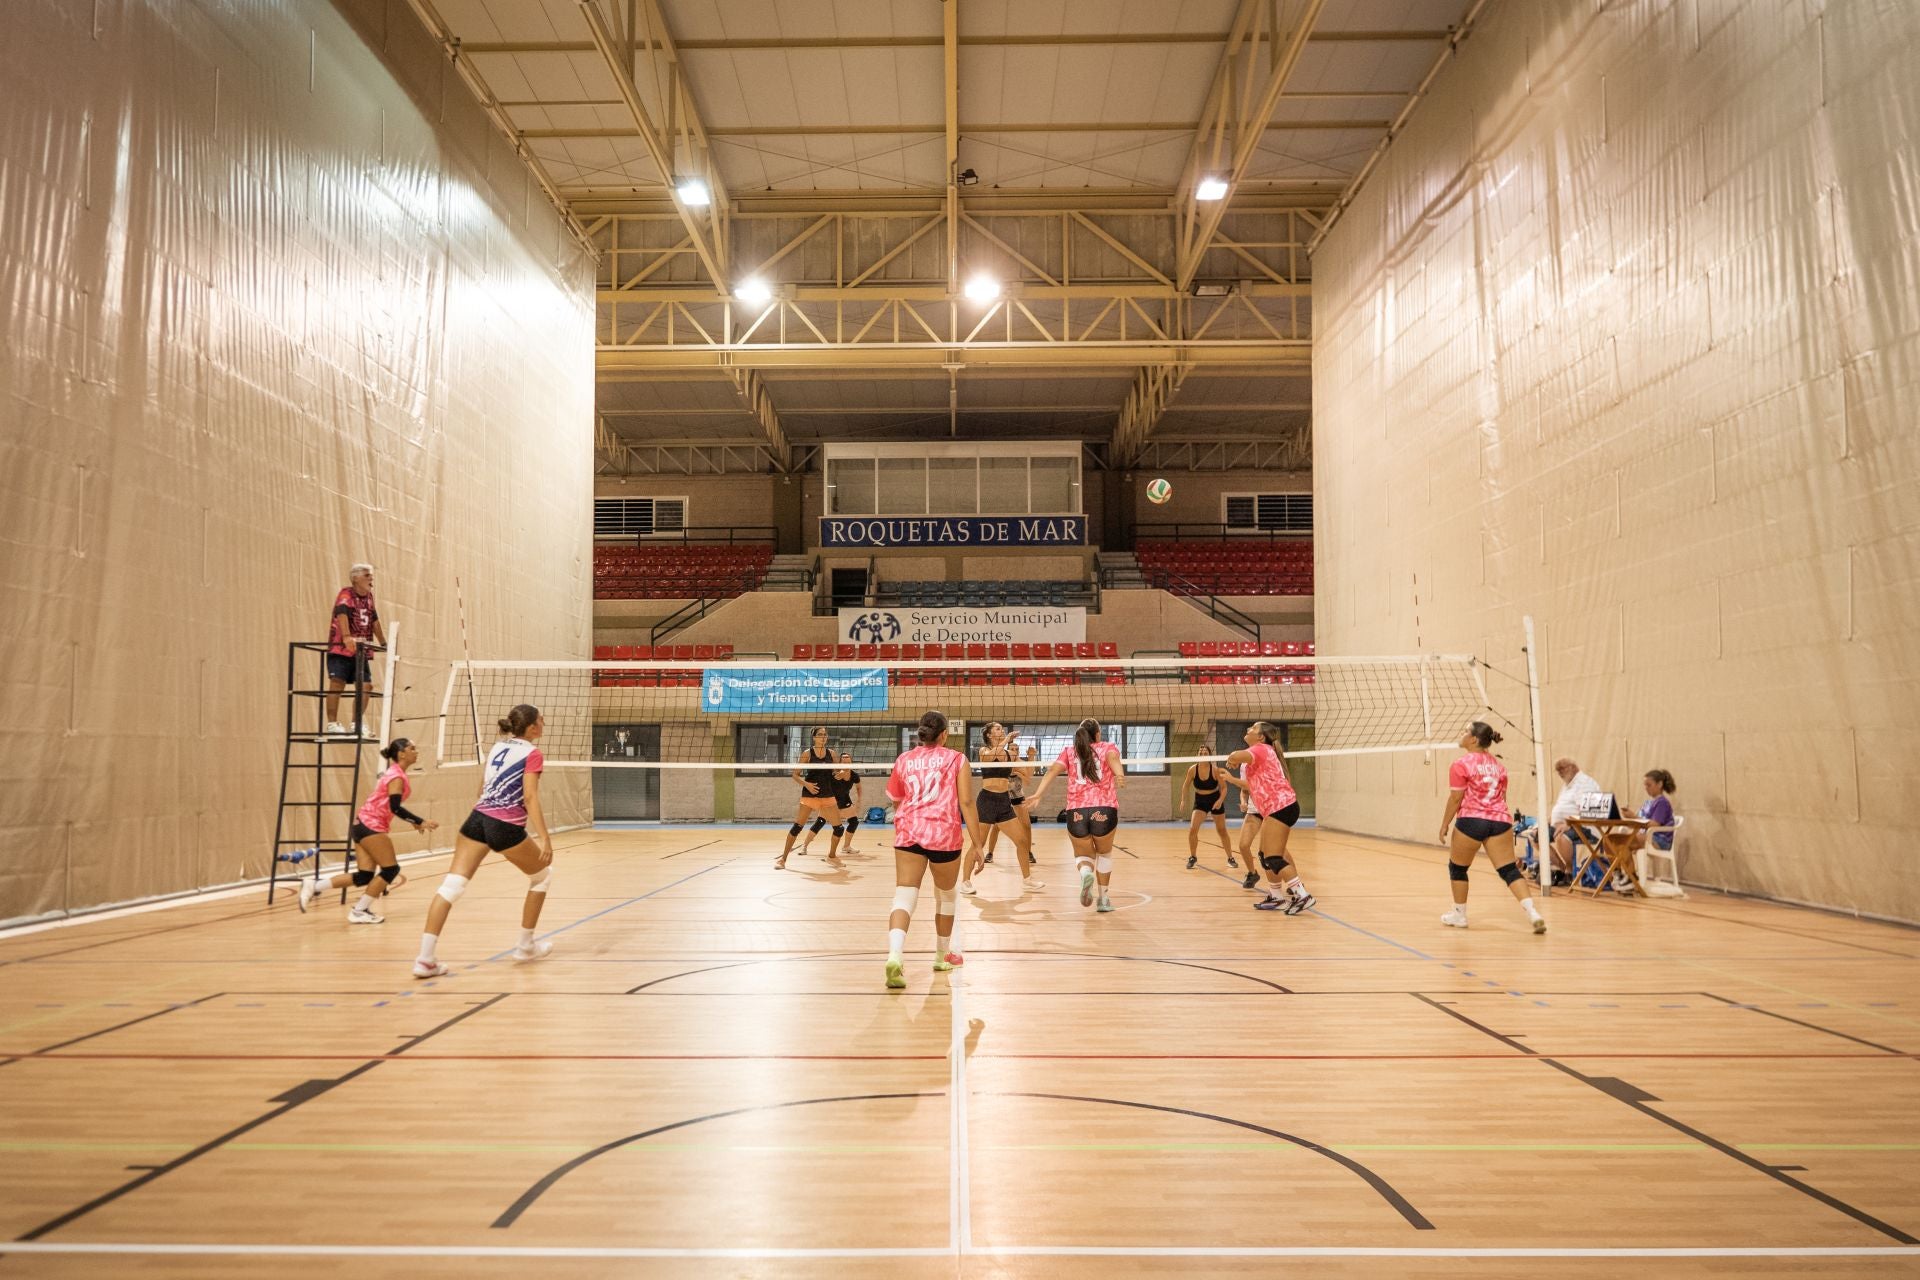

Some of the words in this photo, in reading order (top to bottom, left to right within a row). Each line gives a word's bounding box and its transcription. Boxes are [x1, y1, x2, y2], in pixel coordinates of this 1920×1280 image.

[830, 520, 970, 546] ROQUETAS
[980, 522, 1009, 542] DE
[1018, 519, 1078, 541] MAR
[359, 608, 369, 626] 5
[911, 611, 979, 625] Servicio
[984, 611, 1068, 630] Municipal
[911, 629, 932, 642] de
[937, 628, 1012, 644] Deportes
[729, 675, 801, 690] Delegación
[804, 676, 821, 688] de
[823, 676, 883, 690] Deportes
[757, 694, 766, 706] y
[768, 692, 818, 705] Tiempo
[820, 690, 853, 703] Libre
[491, 748, 510, 771] 4
[1482, 776, 1498, 803] 7
